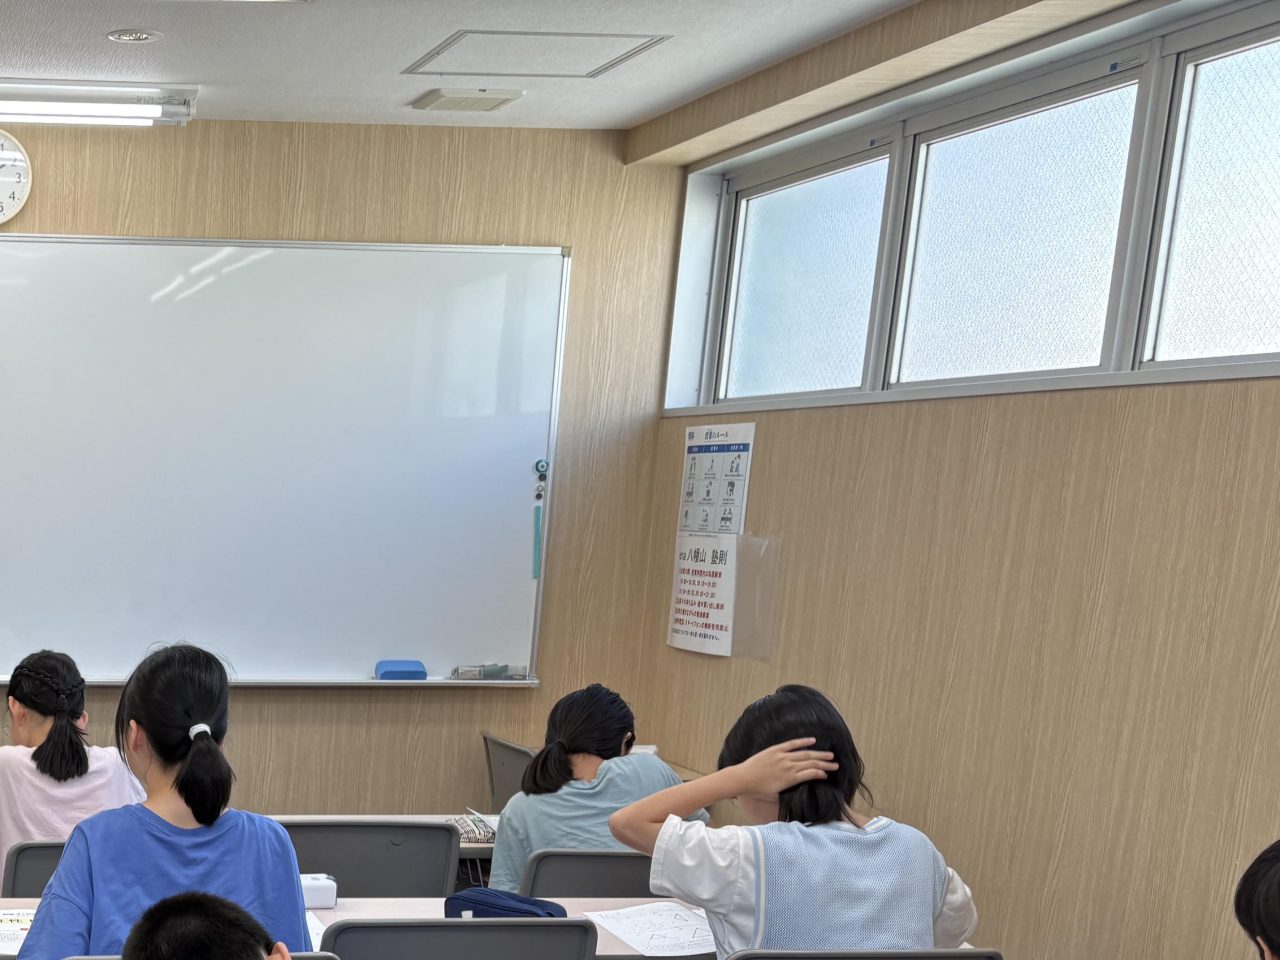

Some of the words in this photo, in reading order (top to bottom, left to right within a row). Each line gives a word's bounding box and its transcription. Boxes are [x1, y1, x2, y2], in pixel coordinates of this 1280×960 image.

[0, 143, 6, 151] 1
[15, 172, 22, 183] 3
[8, 191, 16, 201] 4
